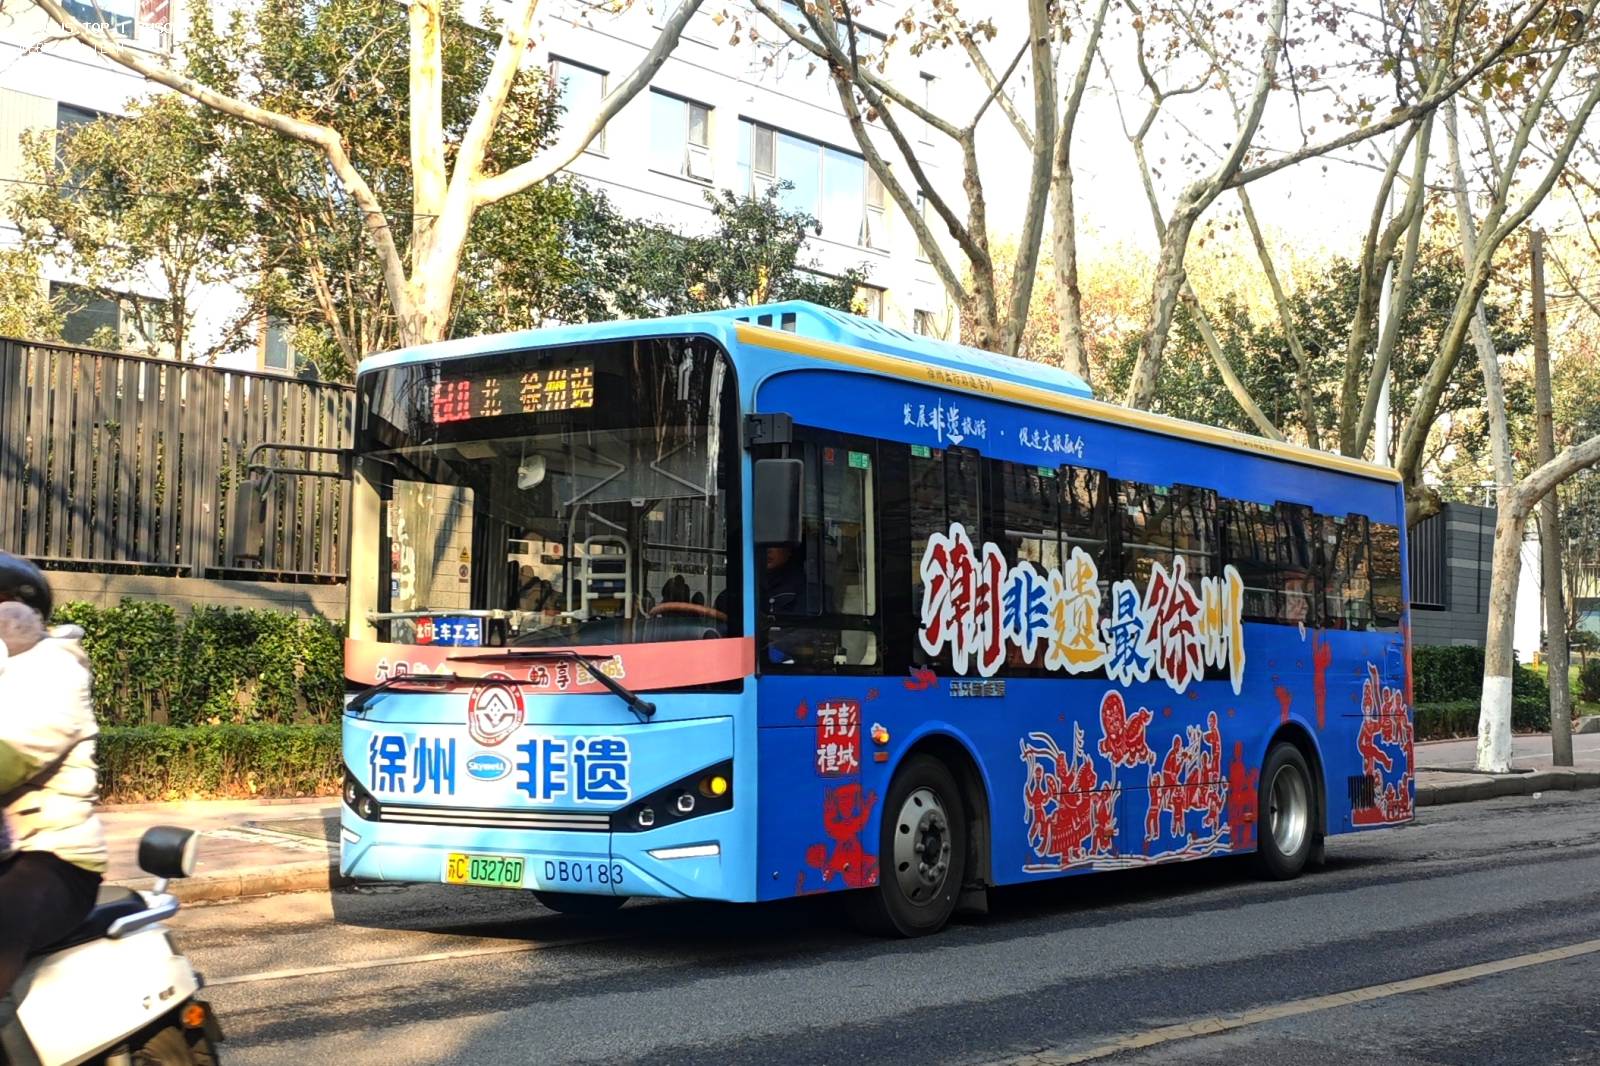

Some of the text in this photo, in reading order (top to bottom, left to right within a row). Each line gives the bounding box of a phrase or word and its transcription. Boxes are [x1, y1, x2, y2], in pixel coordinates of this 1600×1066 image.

[369, 735, 628, 800] 徐州 非遗
[470, 859, 523, 883] 03276D
[544, 861, 624, 885] DB0183
